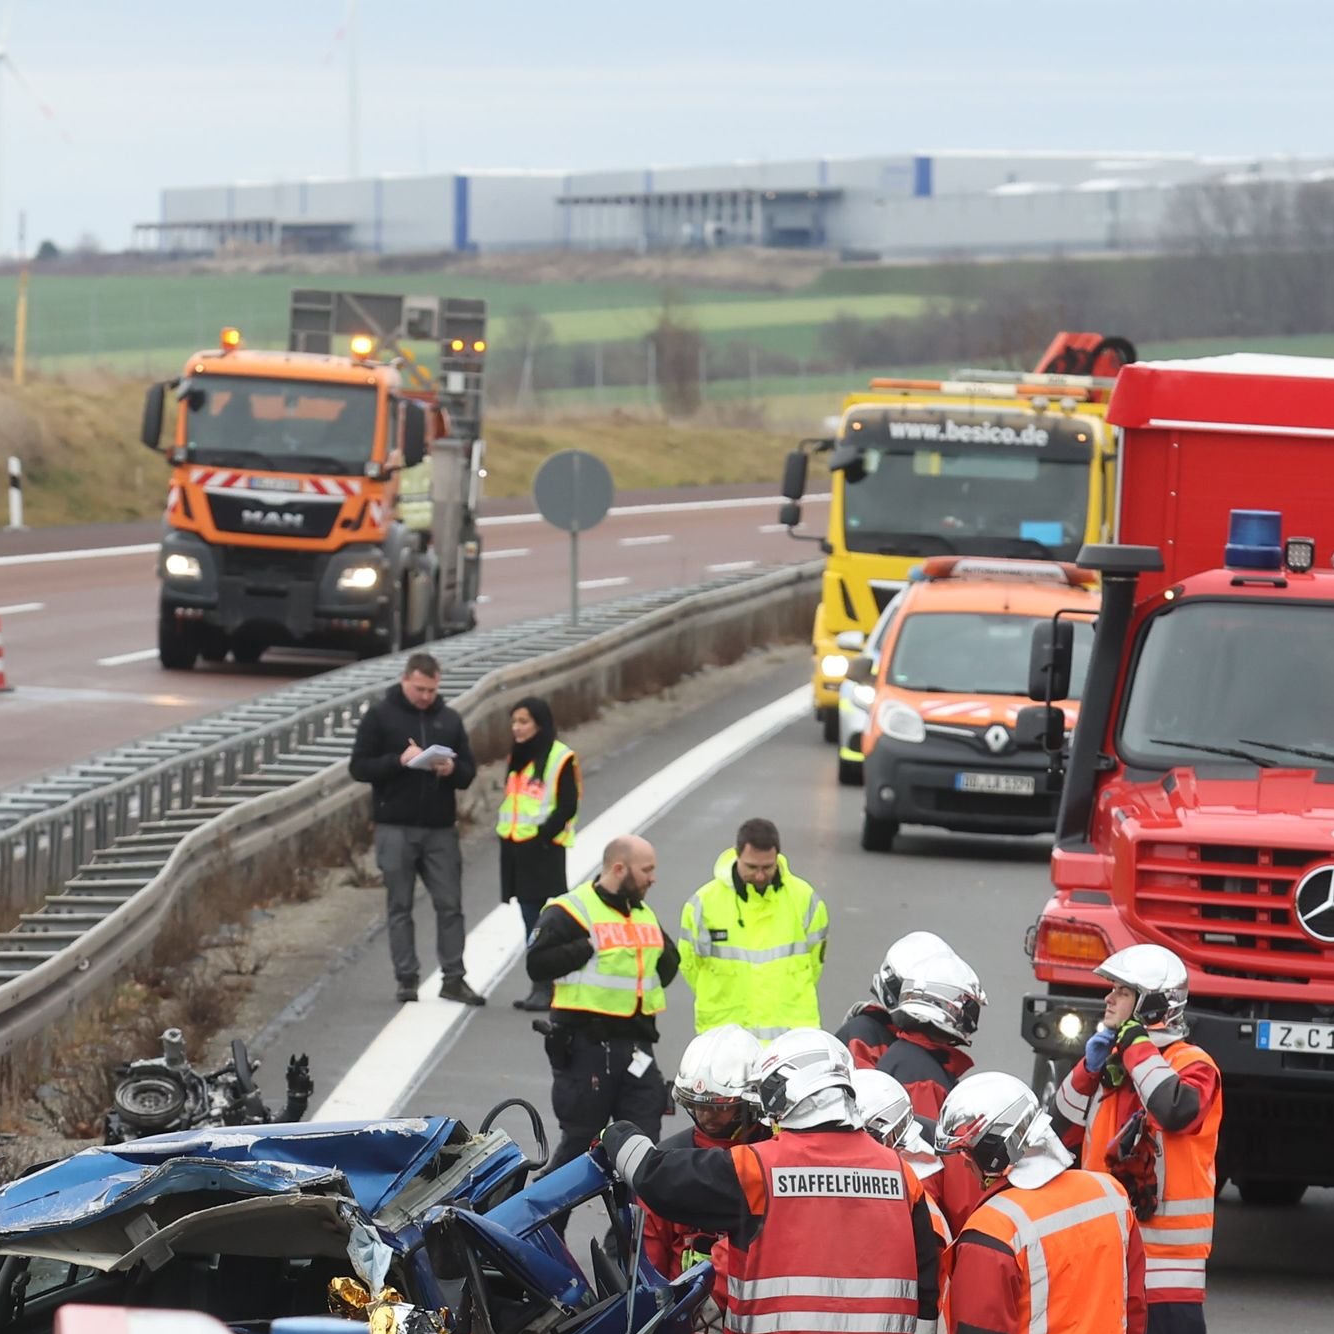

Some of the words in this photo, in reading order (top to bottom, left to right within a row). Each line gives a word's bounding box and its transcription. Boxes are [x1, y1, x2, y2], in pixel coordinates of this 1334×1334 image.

[889, 419, 1049, 447] www.besico.de
[241, 509, 304, 528] MAN
[1279, 1027, 1292, 1047] Z
[1308, 1029, 1320, 1048] C
[778, 1171, 900, 1195] STAFFELFÜHRER
